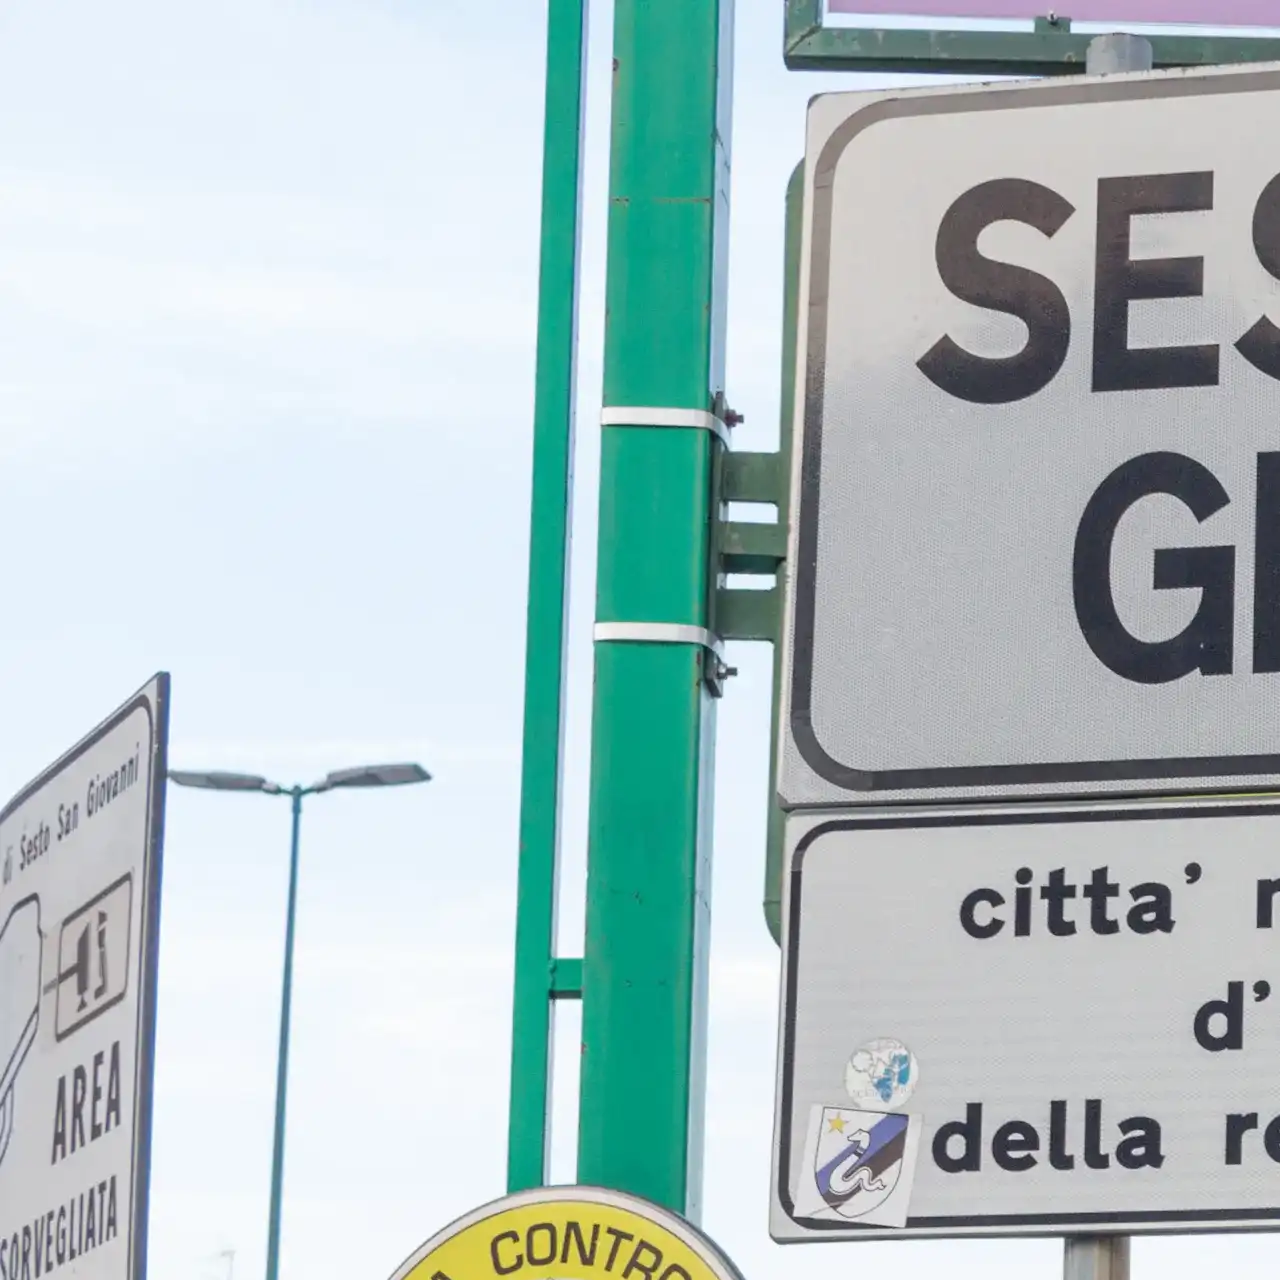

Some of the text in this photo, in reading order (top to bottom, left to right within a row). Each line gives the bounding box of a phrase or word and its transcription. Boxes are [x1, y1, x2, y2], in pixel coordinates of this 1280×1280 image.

[19, 820, 50, 871] Sesto
[57, 802, 79, 842] San
[86, 742, 140, 818] Giovanni
[957, 862, 1203, 939] citta'
[51, 1041, 120, 1165] AREA
[930, 1097, 1166, 1173] della
